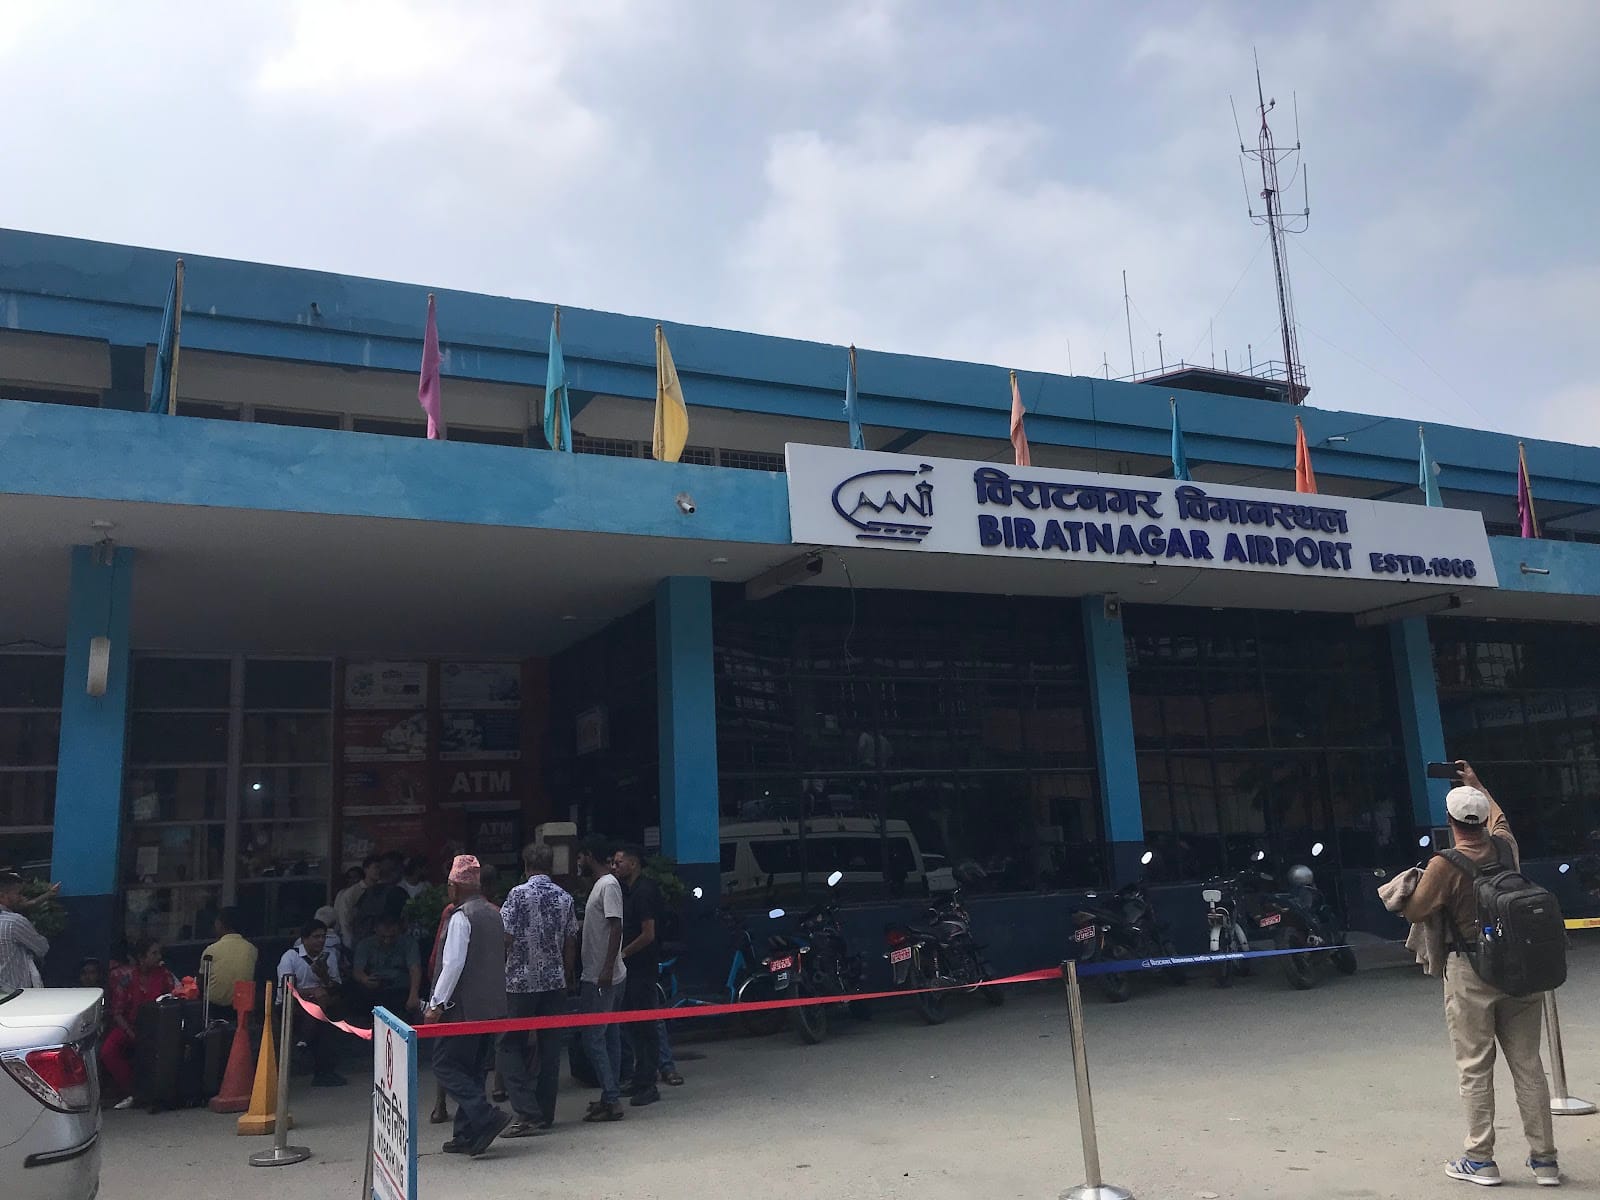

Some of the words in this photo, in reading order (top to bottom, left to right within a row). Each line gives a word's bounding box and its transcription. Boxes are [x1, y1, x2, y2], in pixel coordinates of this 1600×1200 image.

[974, 467, 1164, 519] विराटनगर
[1175, 485, 1349, 534] विमानस्थल
[977, 514, 1215, 561] BIRATNAGAR
[1223, 532, 1352, 571] AIRPORT
[450, 771, 512, 793] ATM
